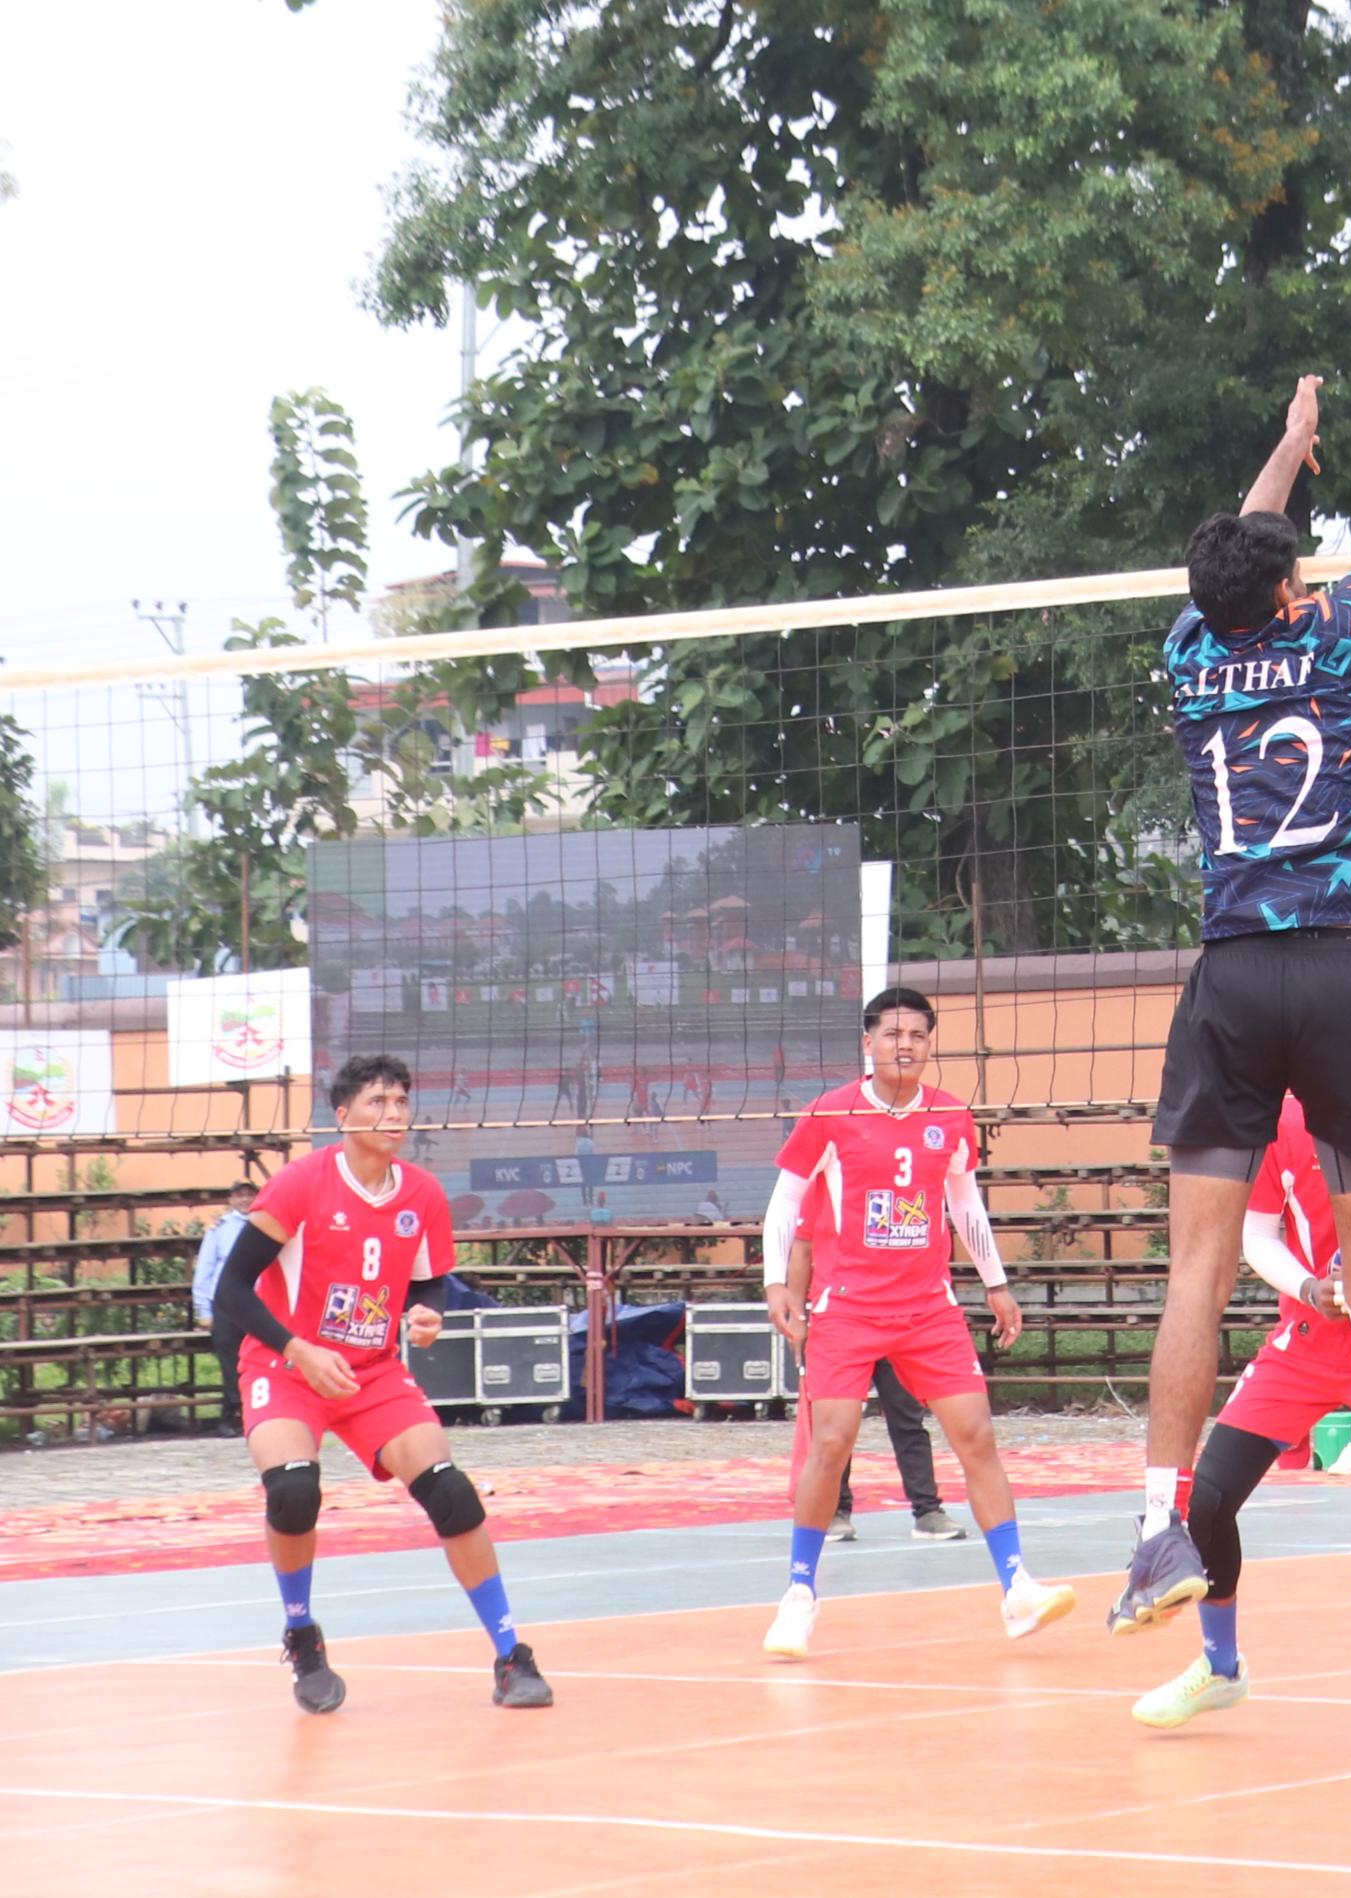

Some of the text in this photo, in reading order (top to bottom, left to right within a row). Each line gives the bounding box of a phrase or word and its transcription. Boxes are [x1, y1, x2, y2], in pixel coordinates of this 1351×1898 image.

[1201, 715, 1339, 856] 12
[495, 1168, 520, 1182] KVC
[666, 1161, 693, 1175] NPC
[894, 1147, 912, 1187] 3
[362, 1237, 382, 1281] 8
[252, 1377, 270, 1409] 8
